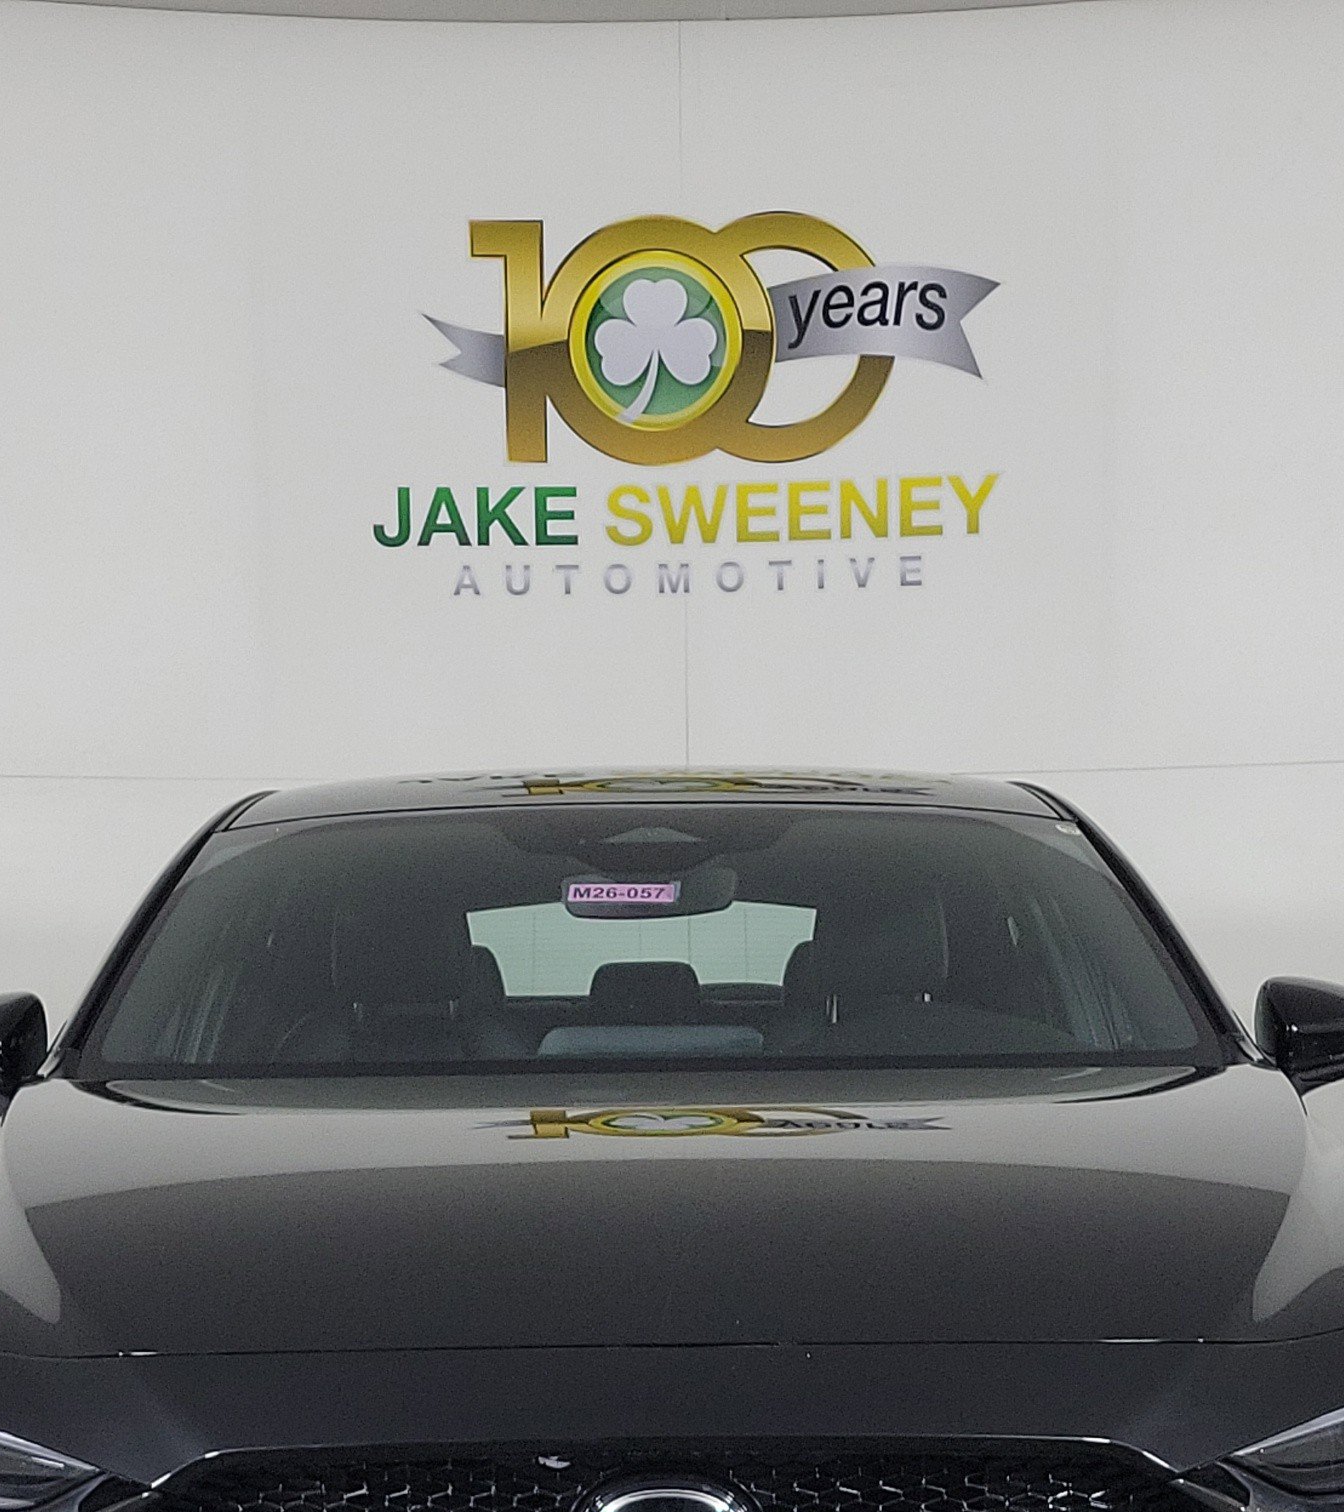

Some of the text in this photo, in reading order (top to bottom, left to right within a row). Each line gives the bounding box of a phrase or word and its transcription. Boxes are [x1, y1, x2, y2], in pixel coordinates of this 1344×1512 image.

[788, 279, 948, 350] years
[372, 473, 1000, 548] JAKE SWEENEY
[453, 555, 924, 597] AUTOMOTIVE
[572, 887, 666, 899] M26-057
